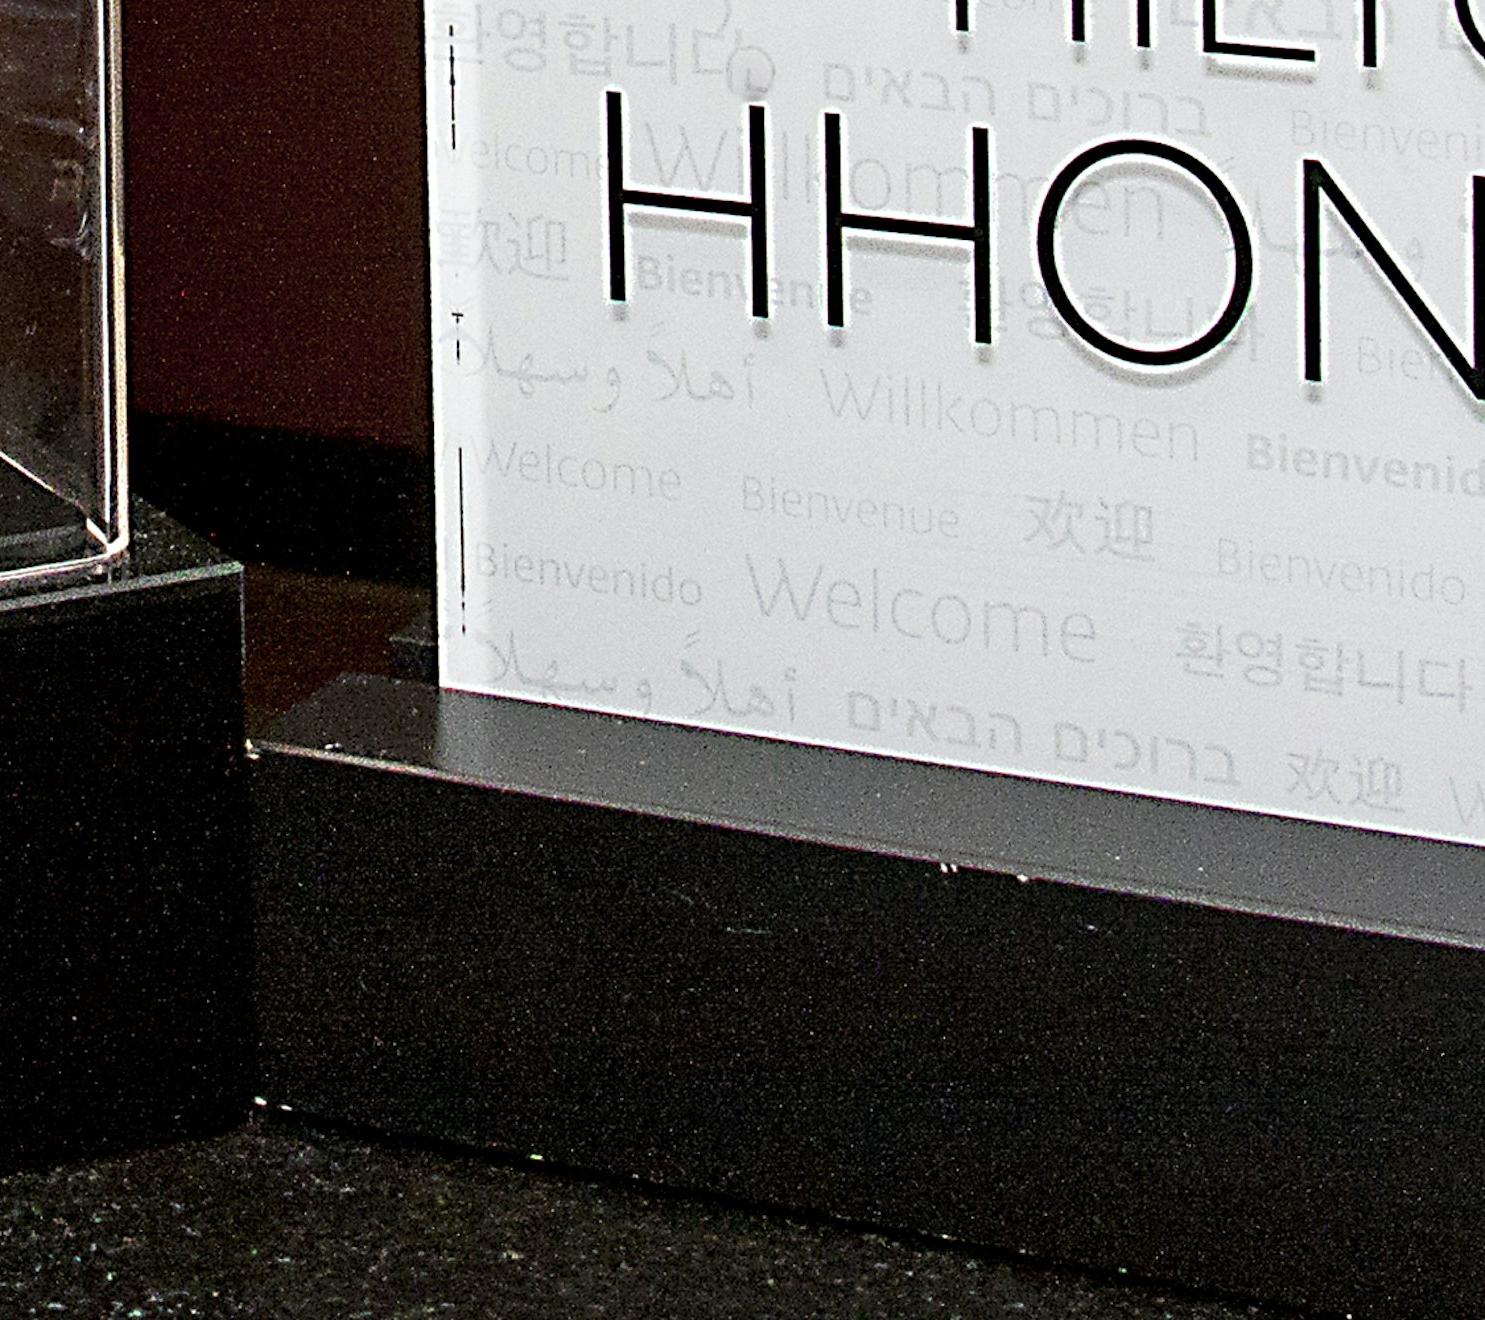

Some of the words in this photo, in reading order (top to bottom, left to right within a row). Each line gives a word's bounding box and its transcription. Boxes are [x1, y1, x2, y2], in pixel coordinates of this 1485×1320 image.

[818, 366, 1201, 465] Willkommen
[741, 473, 963, 541] Bienvenue
[1023, 490, 1158, 562] 欢迎
[743, 551, 1101, 665] Welcome
[1215, 537, 1469, 608] Bienvenido
[1173, 618, 1474, 716] 환영합니다
